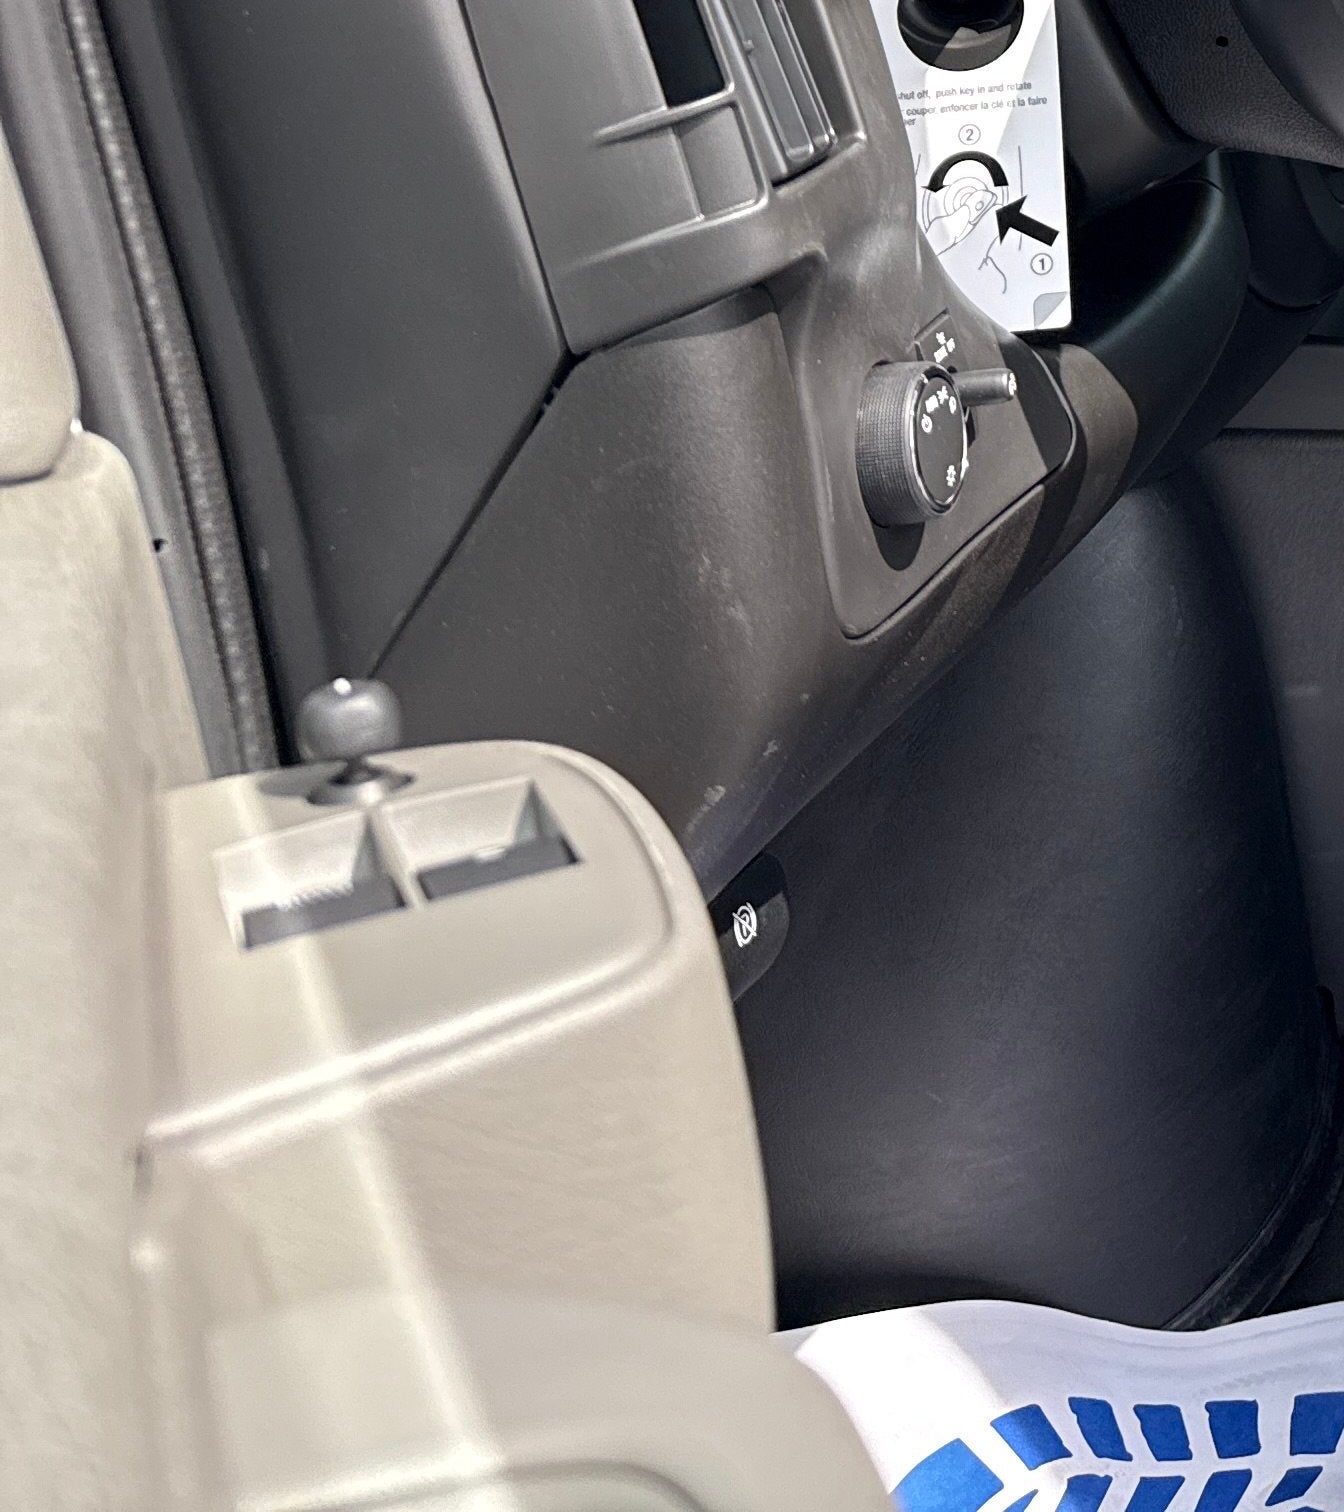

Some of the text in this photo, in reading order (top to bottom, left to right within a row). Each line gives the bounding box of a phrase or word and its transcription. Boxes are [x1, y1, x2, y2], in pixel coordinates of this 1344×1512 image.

[935, 87, 957, 99] push
[959, 86, 974, 97] key
[977, 85, 986, 94] in
[987, 83, 1004, 93] and
[1006, 81, 1032, 92] rotate
[940, 102, 978, 114] enfoncer
[981, 101, 988, 110] la
[991, 99, 1003, 109] clé
[1007, 99, 1016, 109] et
[1017, 98, 1025, 107] la
[1028, 96, 1047, 106] faire
